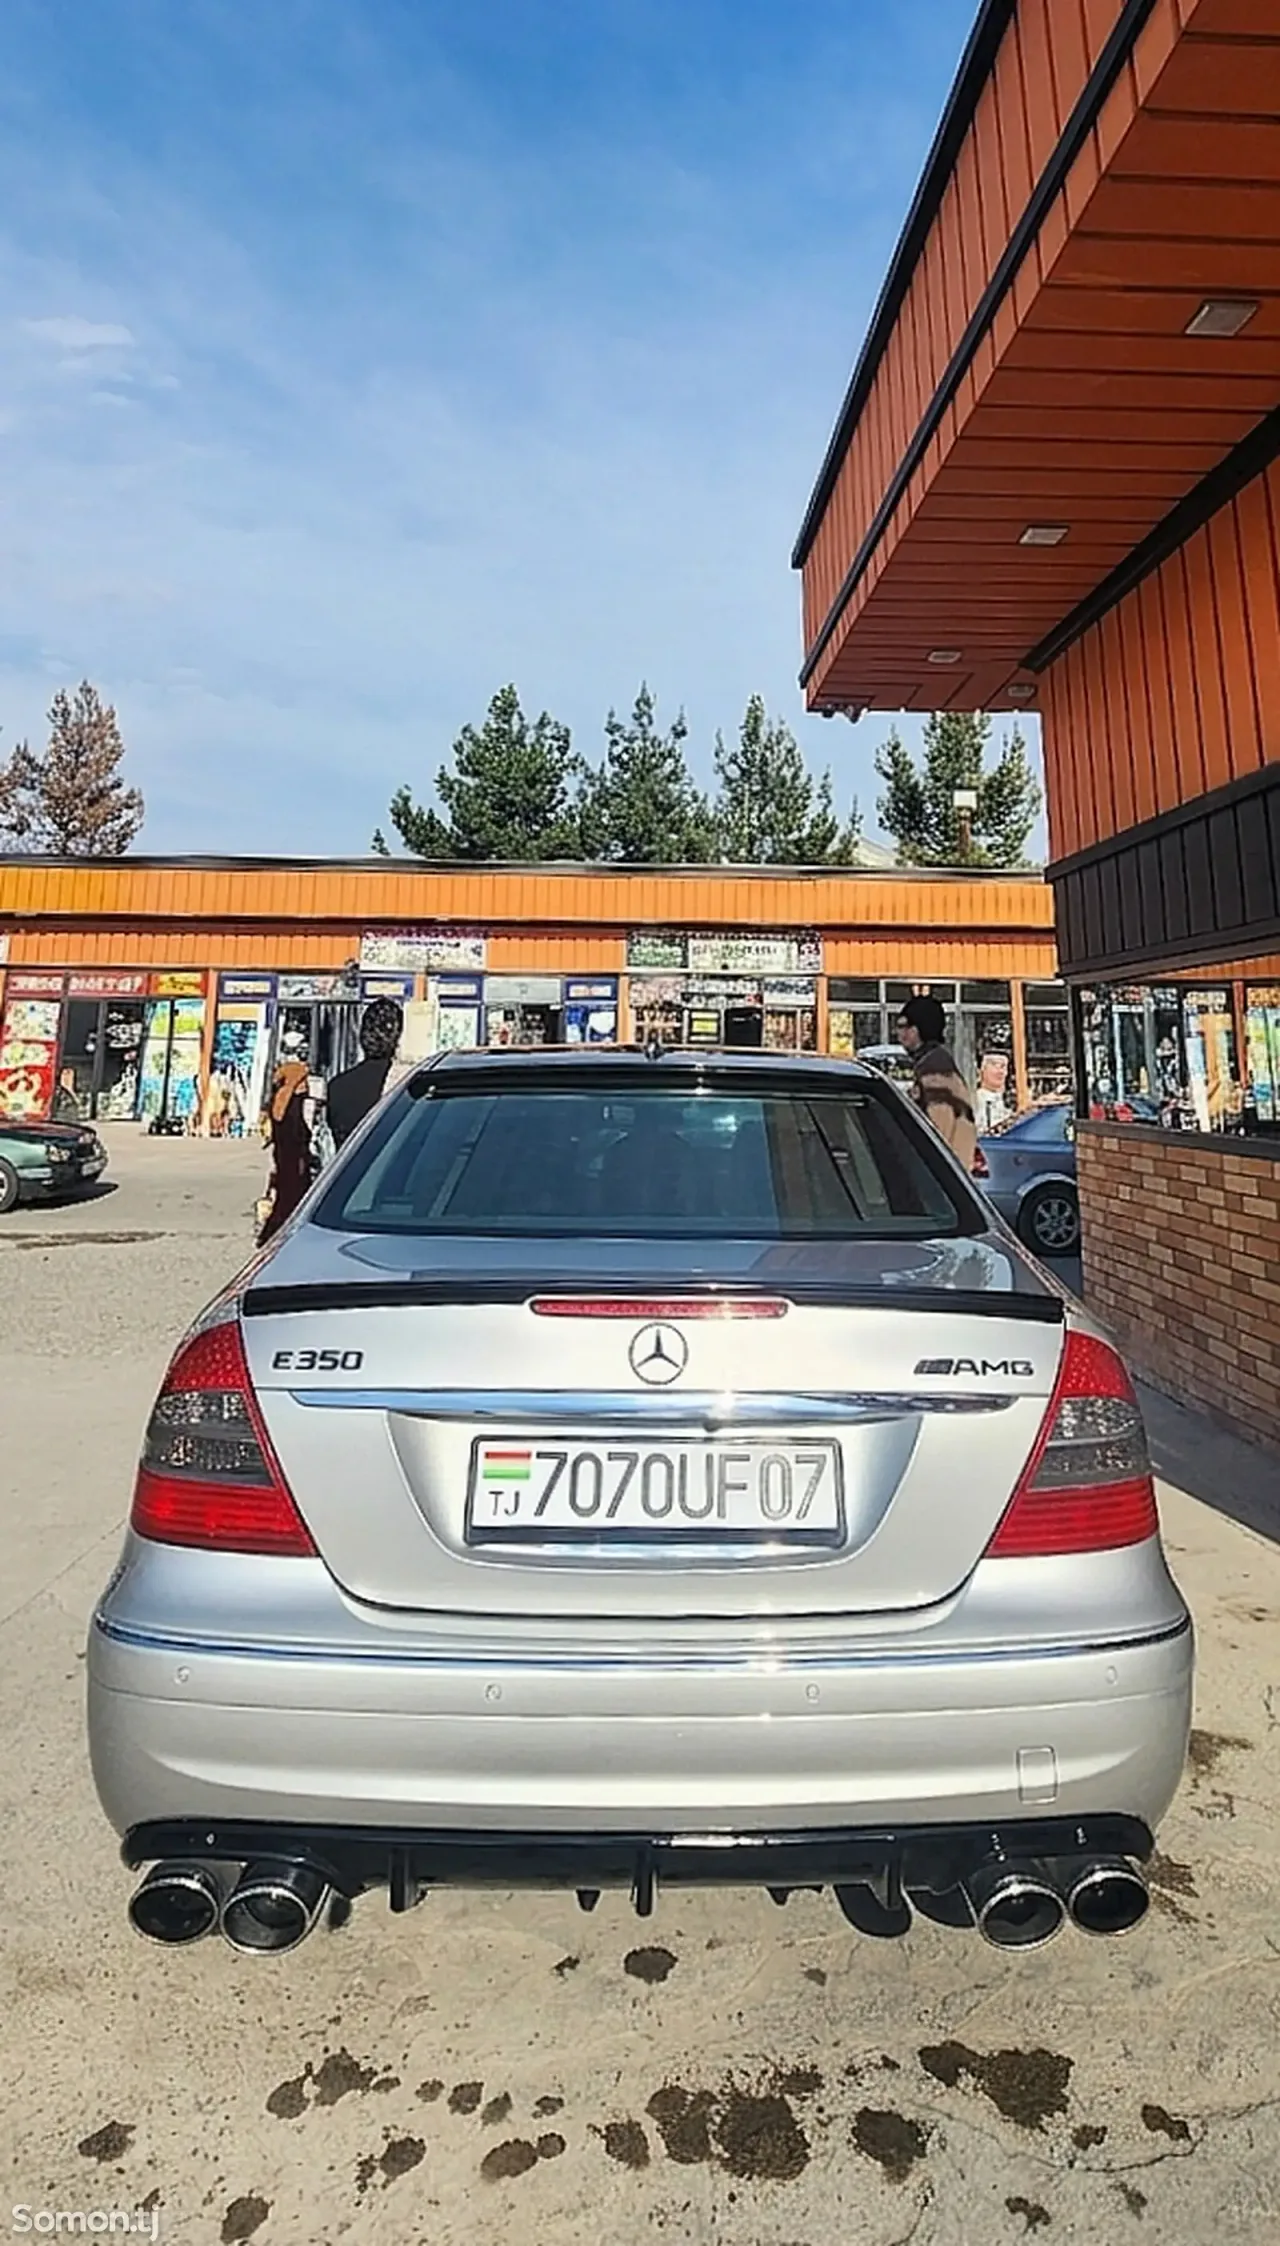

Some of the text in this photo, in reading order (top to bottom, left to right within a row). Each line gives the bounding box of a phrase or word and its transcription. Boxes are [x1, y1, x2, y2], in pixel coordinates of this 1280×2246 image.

[272, 1349, 364, 1371] E350
[953, 1358, 1034, 1377] AMG
[488, 1490, 521, 1517] TJ
